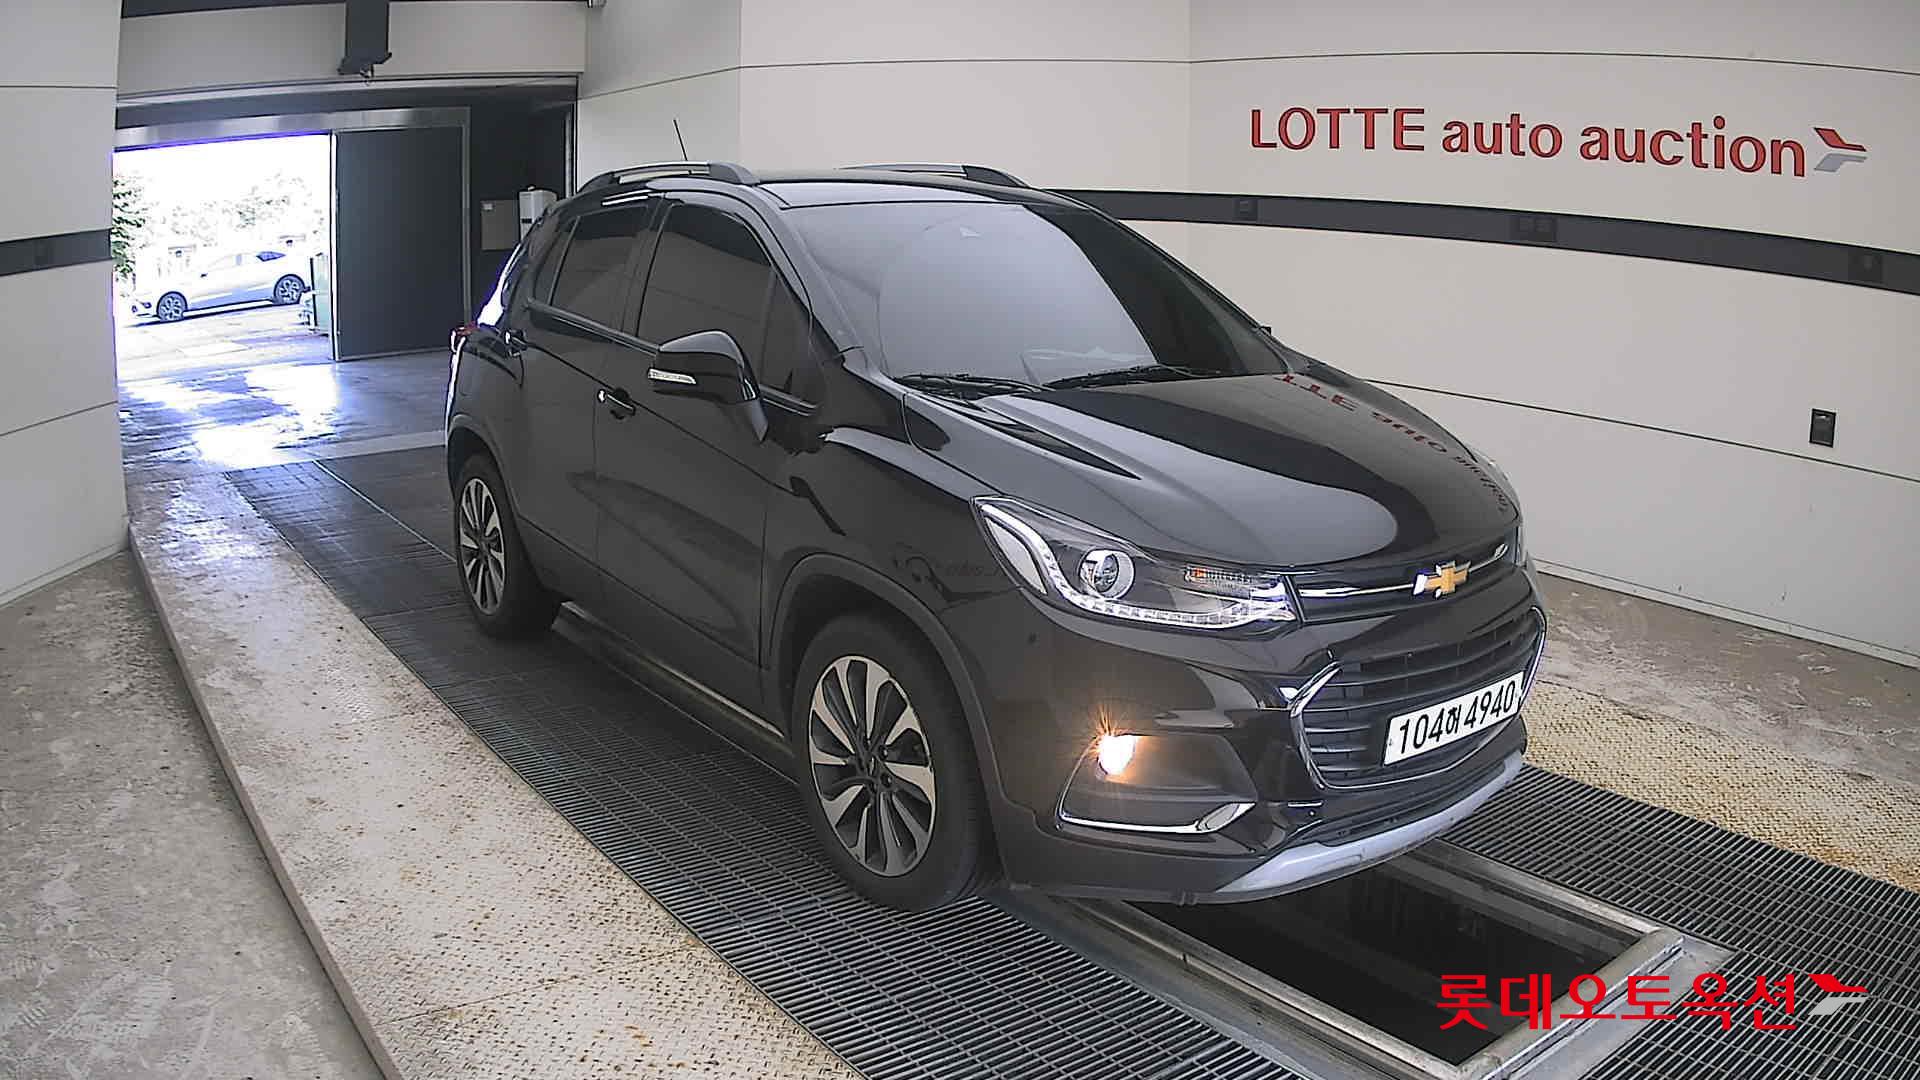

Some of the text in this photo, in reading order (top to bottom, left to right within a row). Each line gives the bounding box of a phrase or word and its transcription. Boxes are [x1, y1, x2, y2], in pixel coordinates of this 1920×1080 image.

[1251, 107, 1806, 177] LOTTE auto auction
[1463, 680, 1517, 729] 4940
